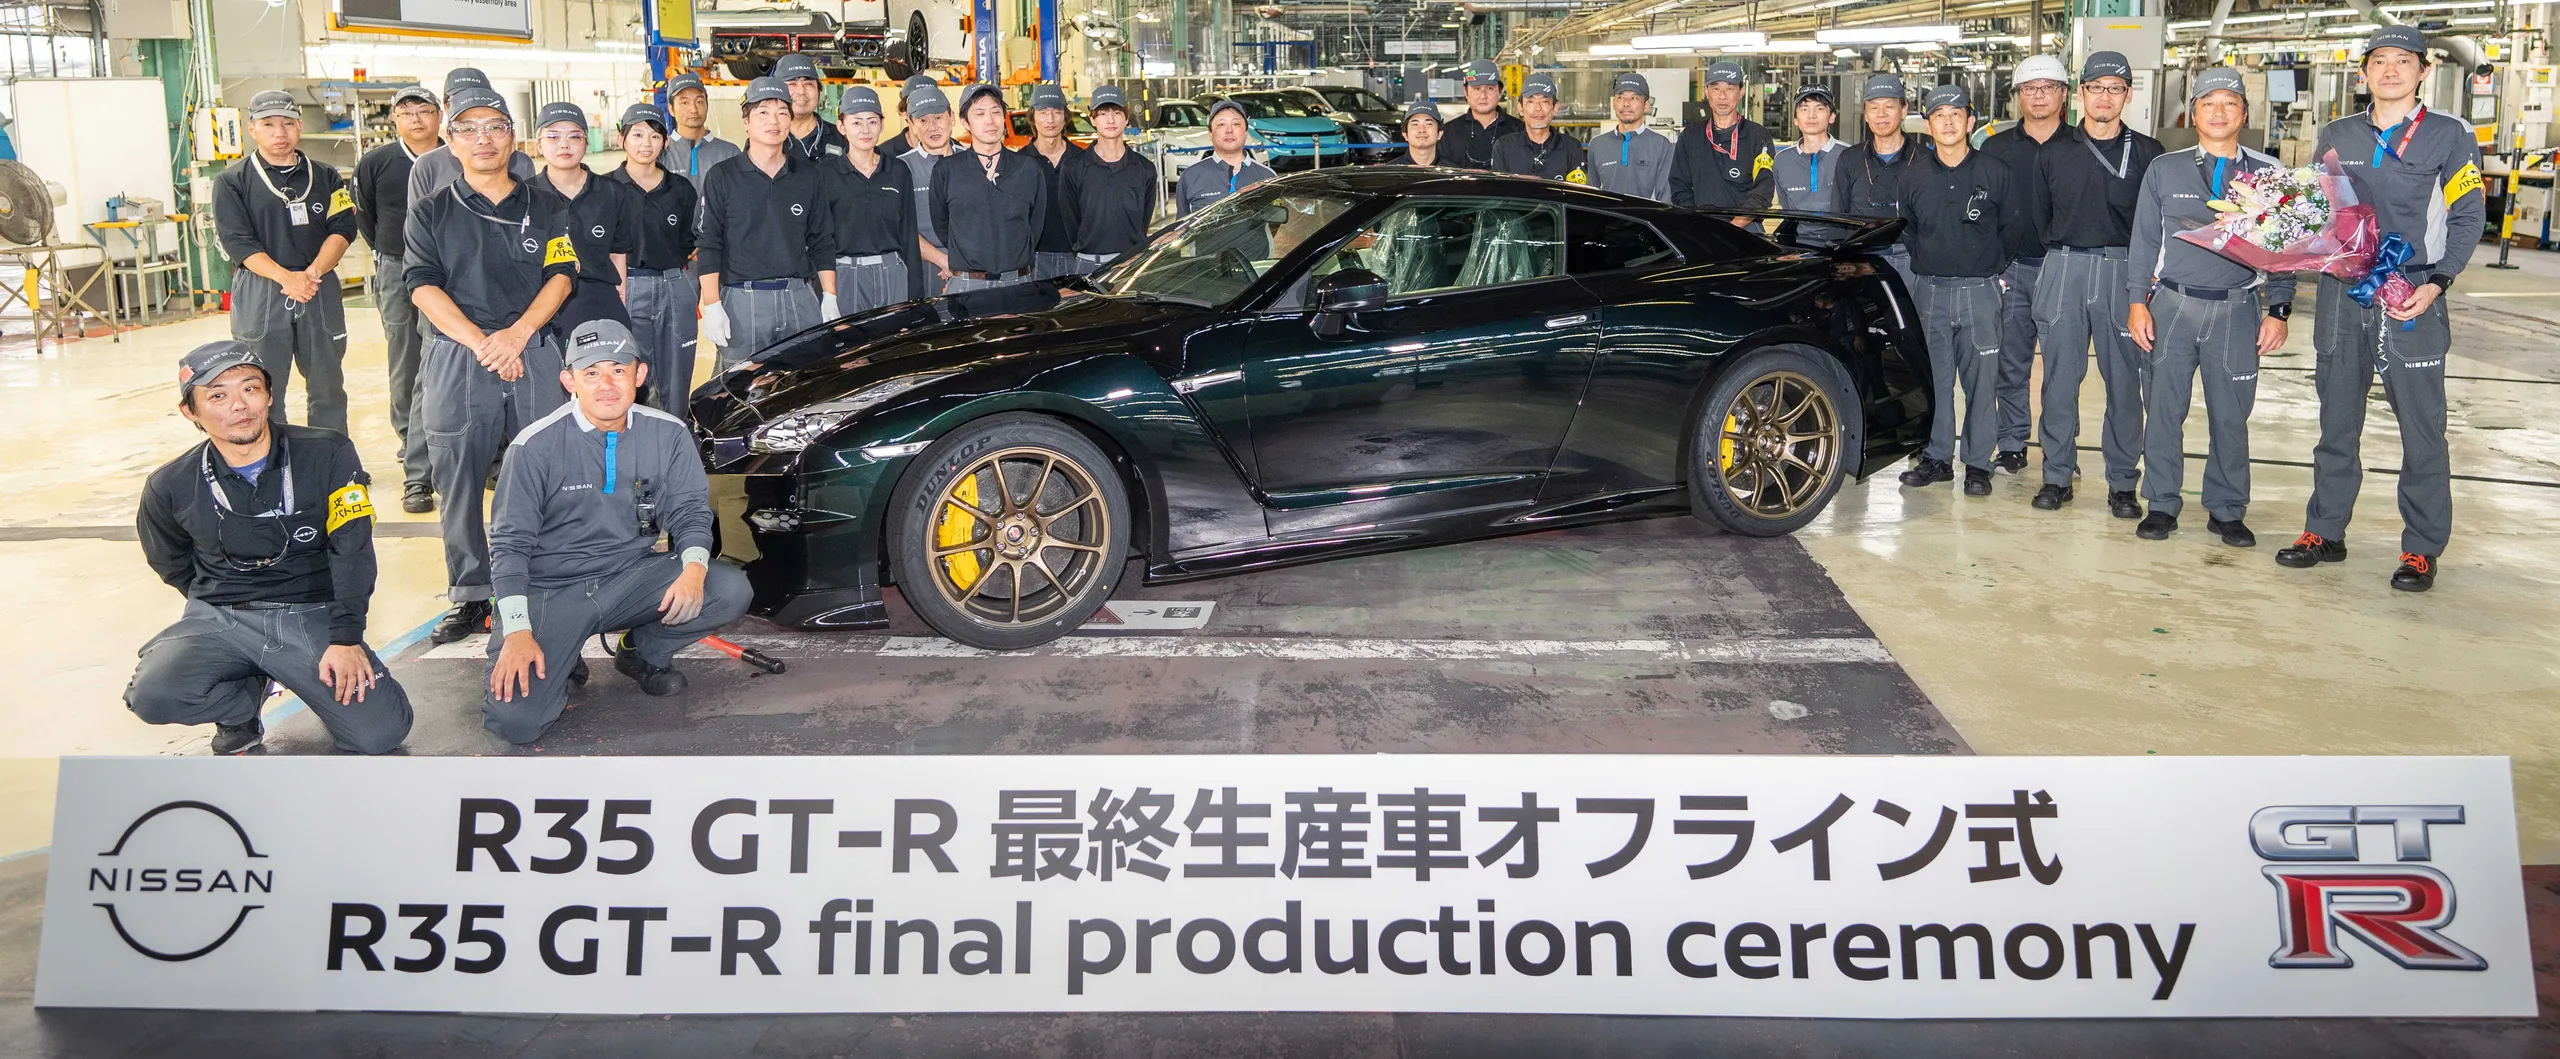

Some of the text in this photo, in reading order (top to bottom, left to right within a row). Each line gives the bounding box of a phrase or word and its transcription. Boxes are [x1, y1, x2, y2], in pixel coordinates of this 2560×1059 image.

[2377, 34, 2409, 42] NISSAN
[461, 96, 494, 105] NISSAN
[916, 97, 937, 106] NISSAN
[636, 110, 661, 118] NISSAN
[583, 340, 620, 350] NISSAN
[203, 351, 243, 366] NISSAN
[2405, 359, 2441, 369] NISSAN
[916, 435, 992, 515] DUNLOP
[562, 483, 593, 491] NISSAN
[456, 787, 2063, 885] R35 GT-R 最終生産車オフライン式
[89, 868, 272, 893] NISSAN
[327, 898, 2196, 1000] R35 GT-R final production ceremony
